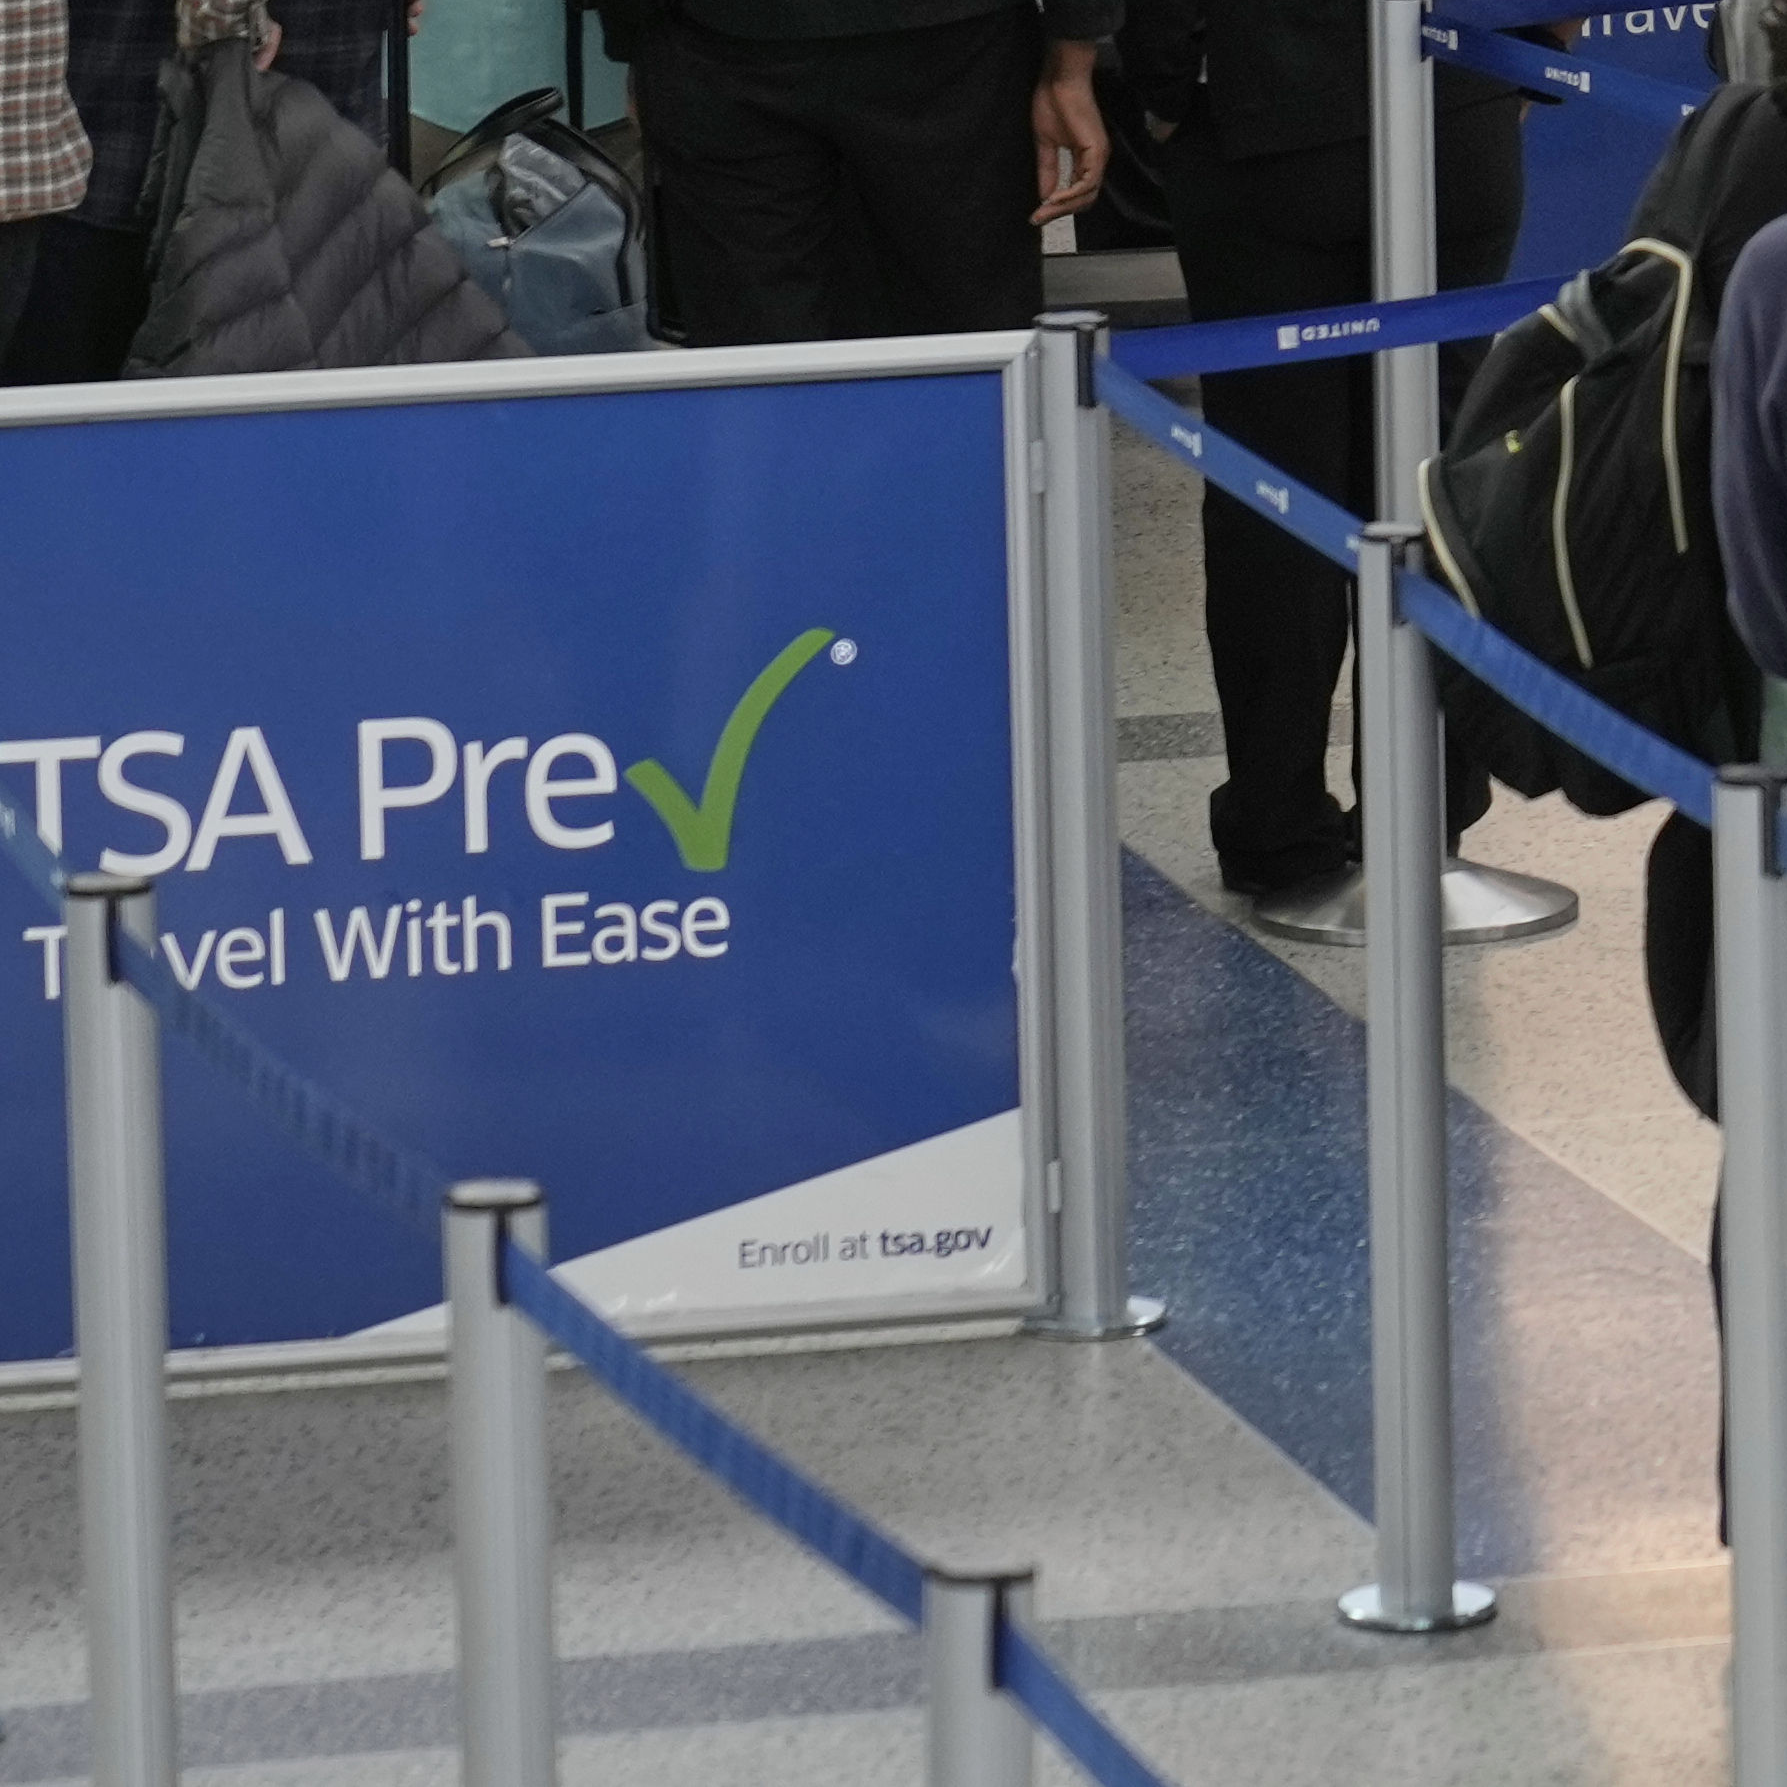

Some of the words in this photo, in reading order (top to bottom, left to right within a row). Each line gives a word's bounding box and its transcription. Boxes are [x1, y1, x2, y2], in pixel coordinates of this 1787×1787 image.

[1302, 318, 1381, 340] UNITED
[0, 725, 313, 878] TSA
[358, 716, 616, 861] Pre
[22, 907, 286, 1001] Tvel
[312, 895, 513, 982] With
[541, 890, 731, 967] Ease
[738, 1234, 829, 1269] Enroll
[838, 1234, 871, 1261] at
[879, 1225, 994, 1259] tsa.gov
